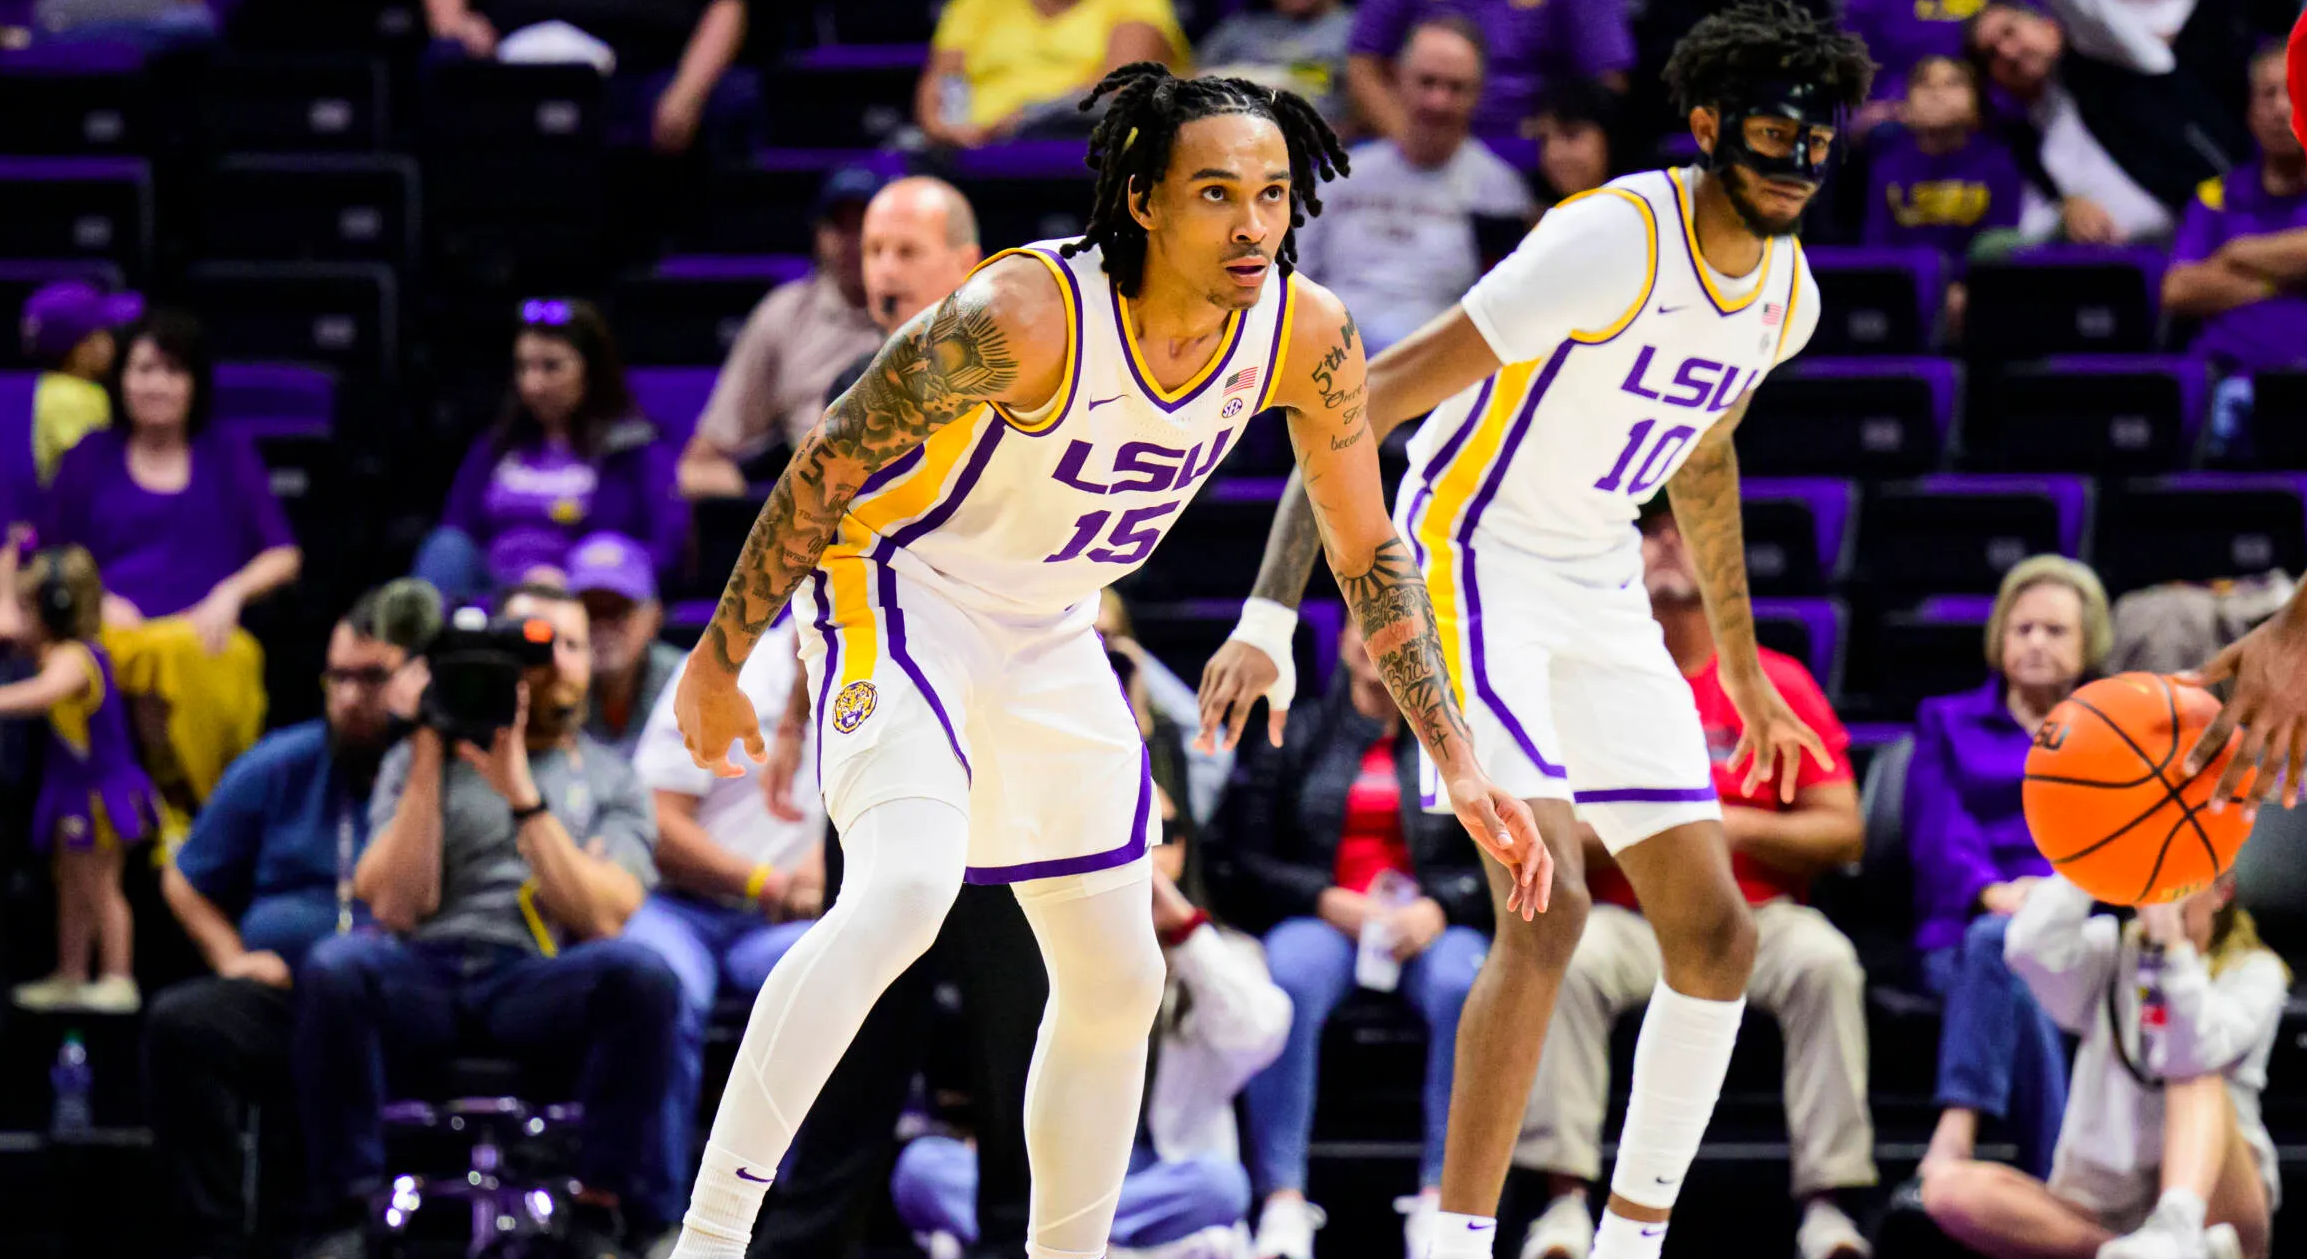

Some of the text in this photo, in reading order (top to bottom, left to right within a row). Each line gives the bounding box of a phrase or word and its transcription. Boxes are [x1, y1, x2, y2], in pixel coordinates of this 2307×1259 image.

[1620, 345, 1759, 412] LSU
[1051, 426, 1234, 495] LSU
[1593, 418, 1697, 495] 10
[1043, 500, 1181, 564] 15
